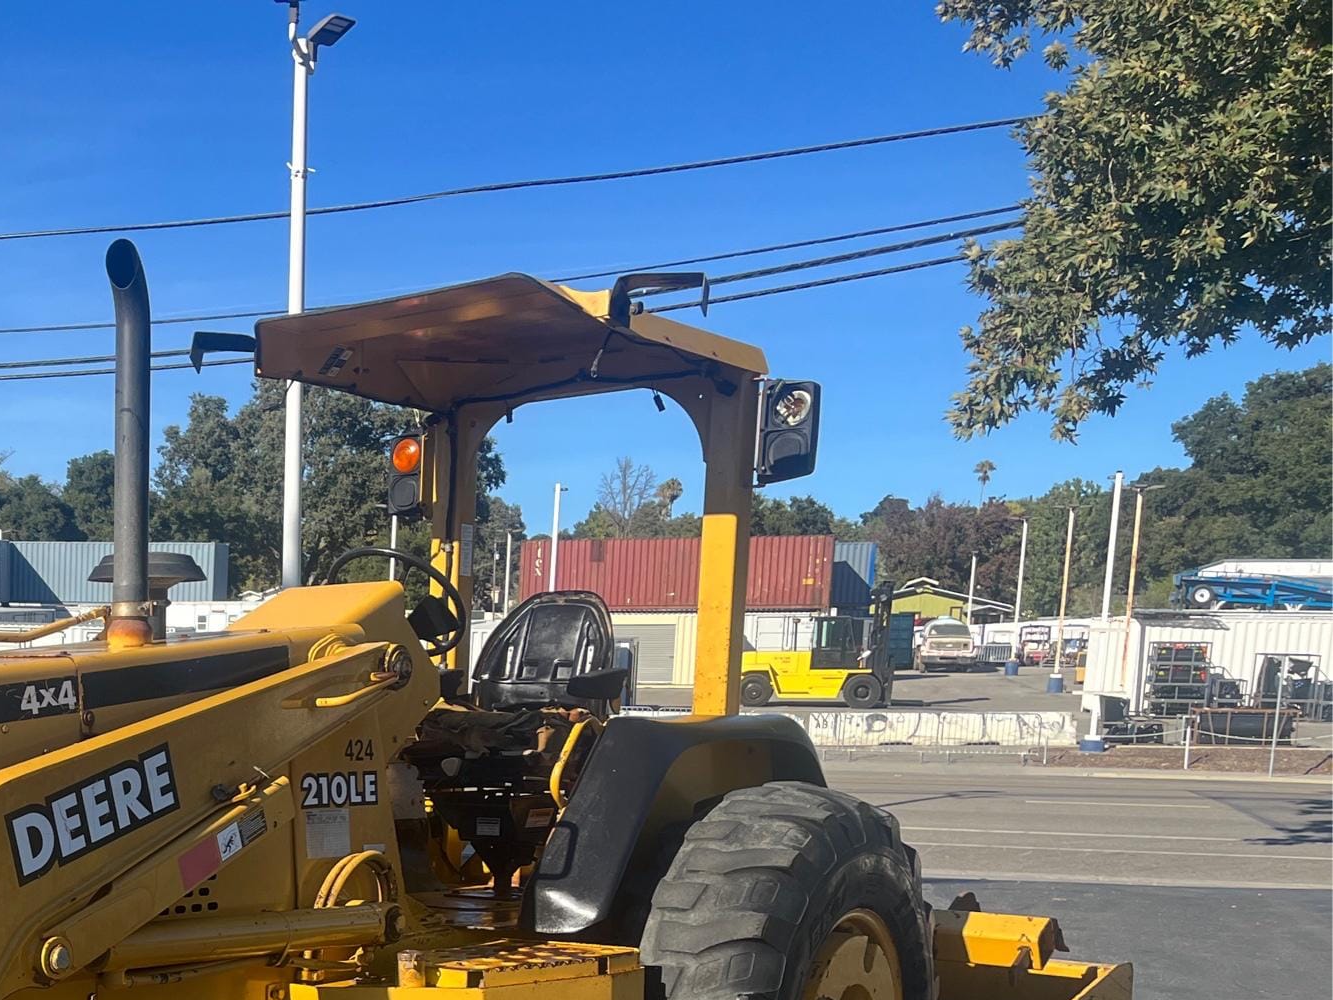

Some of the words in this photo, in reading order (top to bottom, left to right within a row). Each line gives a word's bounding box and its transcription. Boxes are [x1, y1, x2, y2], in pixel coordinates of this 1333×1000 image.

[20, 680, 77, 715] 4x4
[344, 739, 374, 761] 424
[302, 773, 377, 807] 210LE
[11, 750, 176, 877] DEERE
